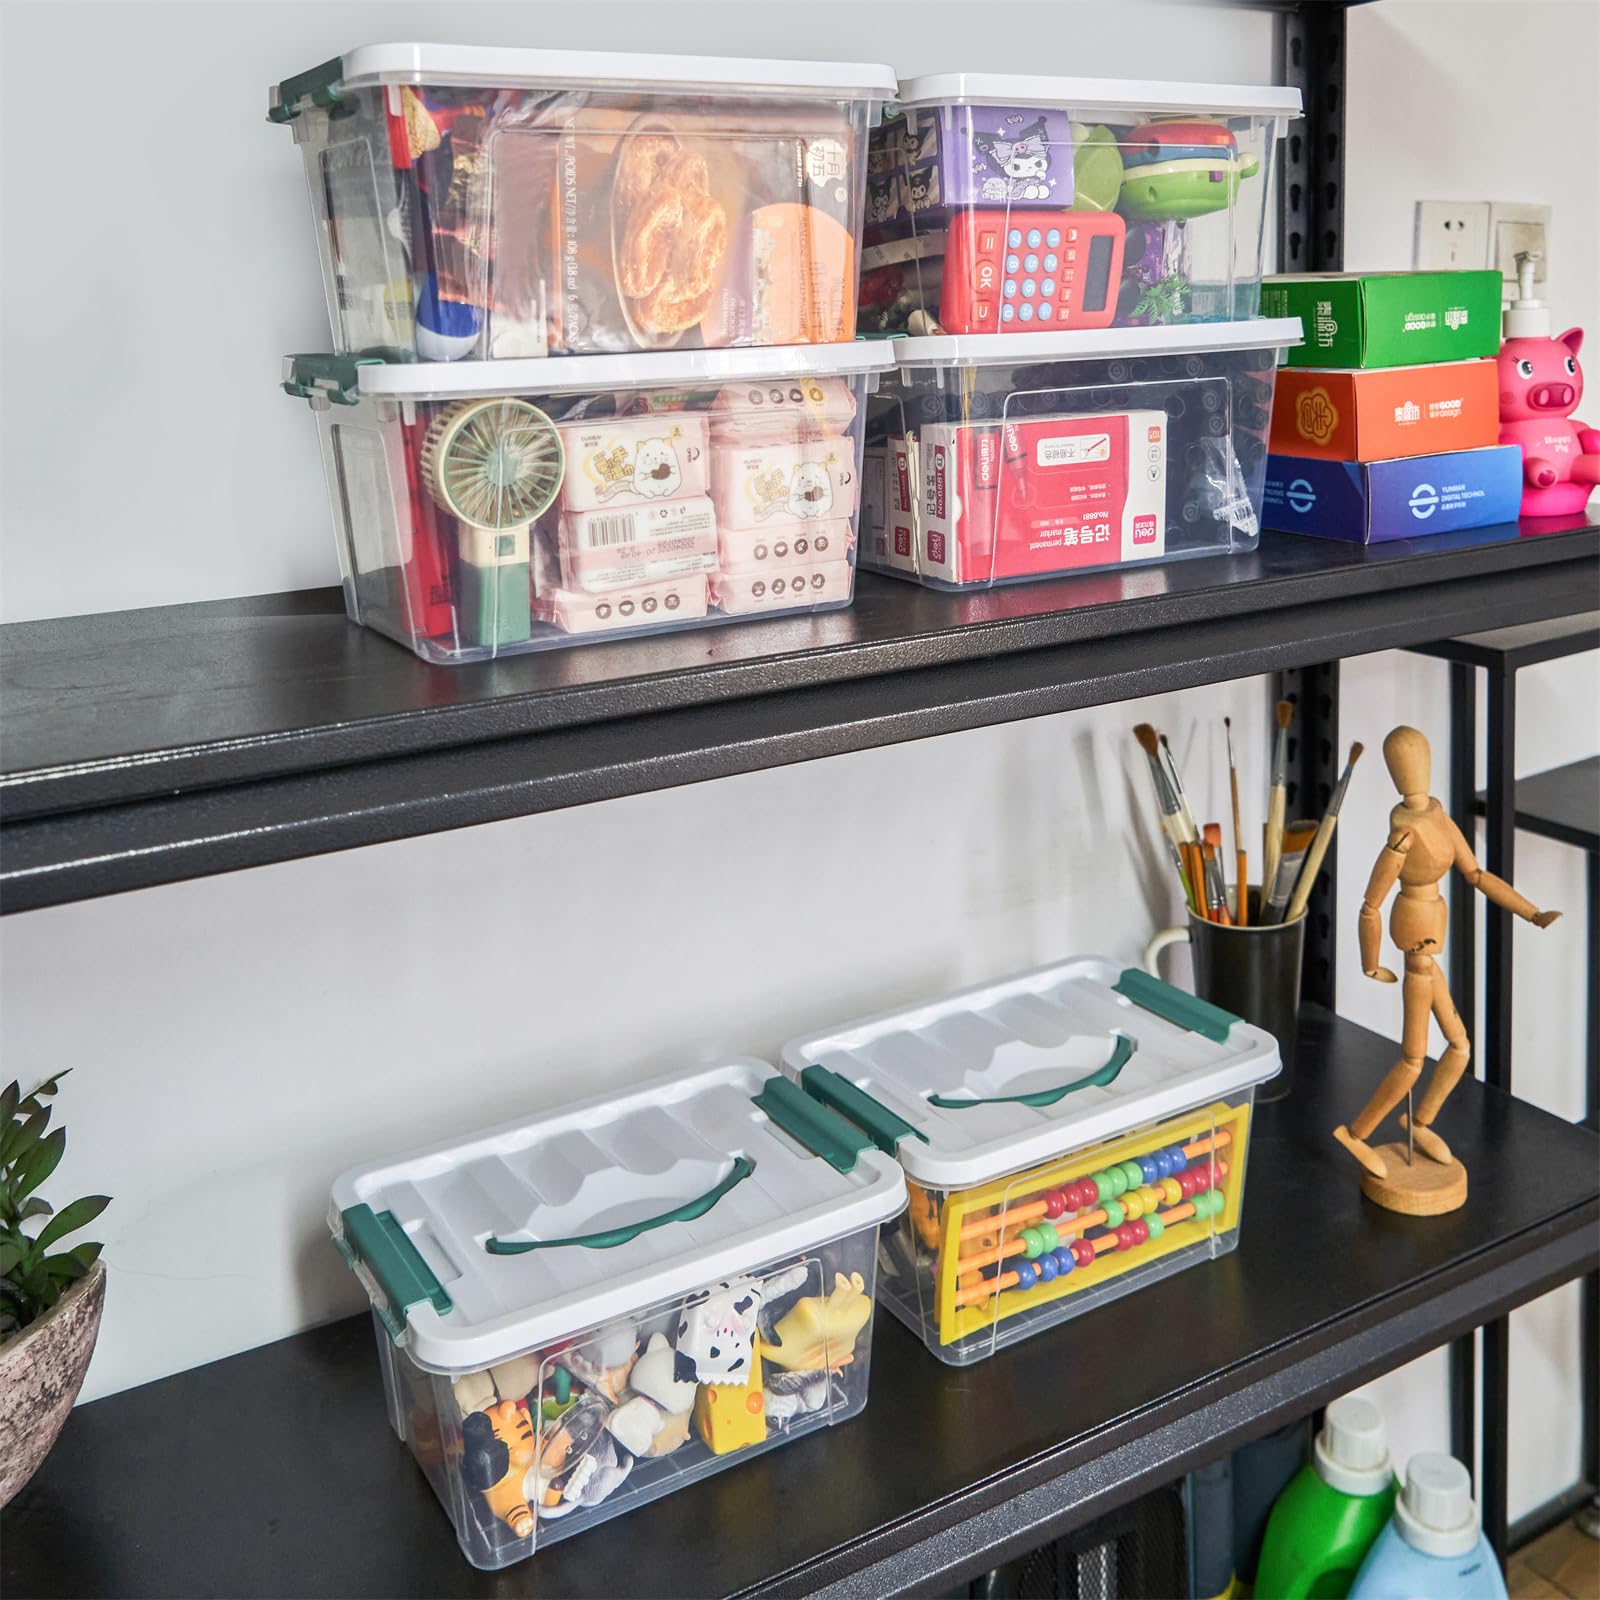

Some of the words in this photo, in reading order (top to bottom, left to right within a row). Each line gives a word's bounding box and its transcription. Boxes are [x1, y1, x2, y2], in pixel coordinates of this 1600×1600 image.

[812, 144, 827, 178] 初五
[826, 144, 841, 175] 十月
[980, 266, 993, 288] OK
[1439, 399, 1461, 409] GOOD
[1441, 493, 1461, 502] DIGITAL
[1461, 490, 1485, 500] TECHNOL
[1083, 511, 1109, 521] No.6881
[1040, 528, 1062, 538] marker
[1063, 523, 1111, 547] 记号笔
[1135, 527, 1154, 538] deli
[931, 534, 940, 559] deli
[1029, 538, 1062, 550] permanent
